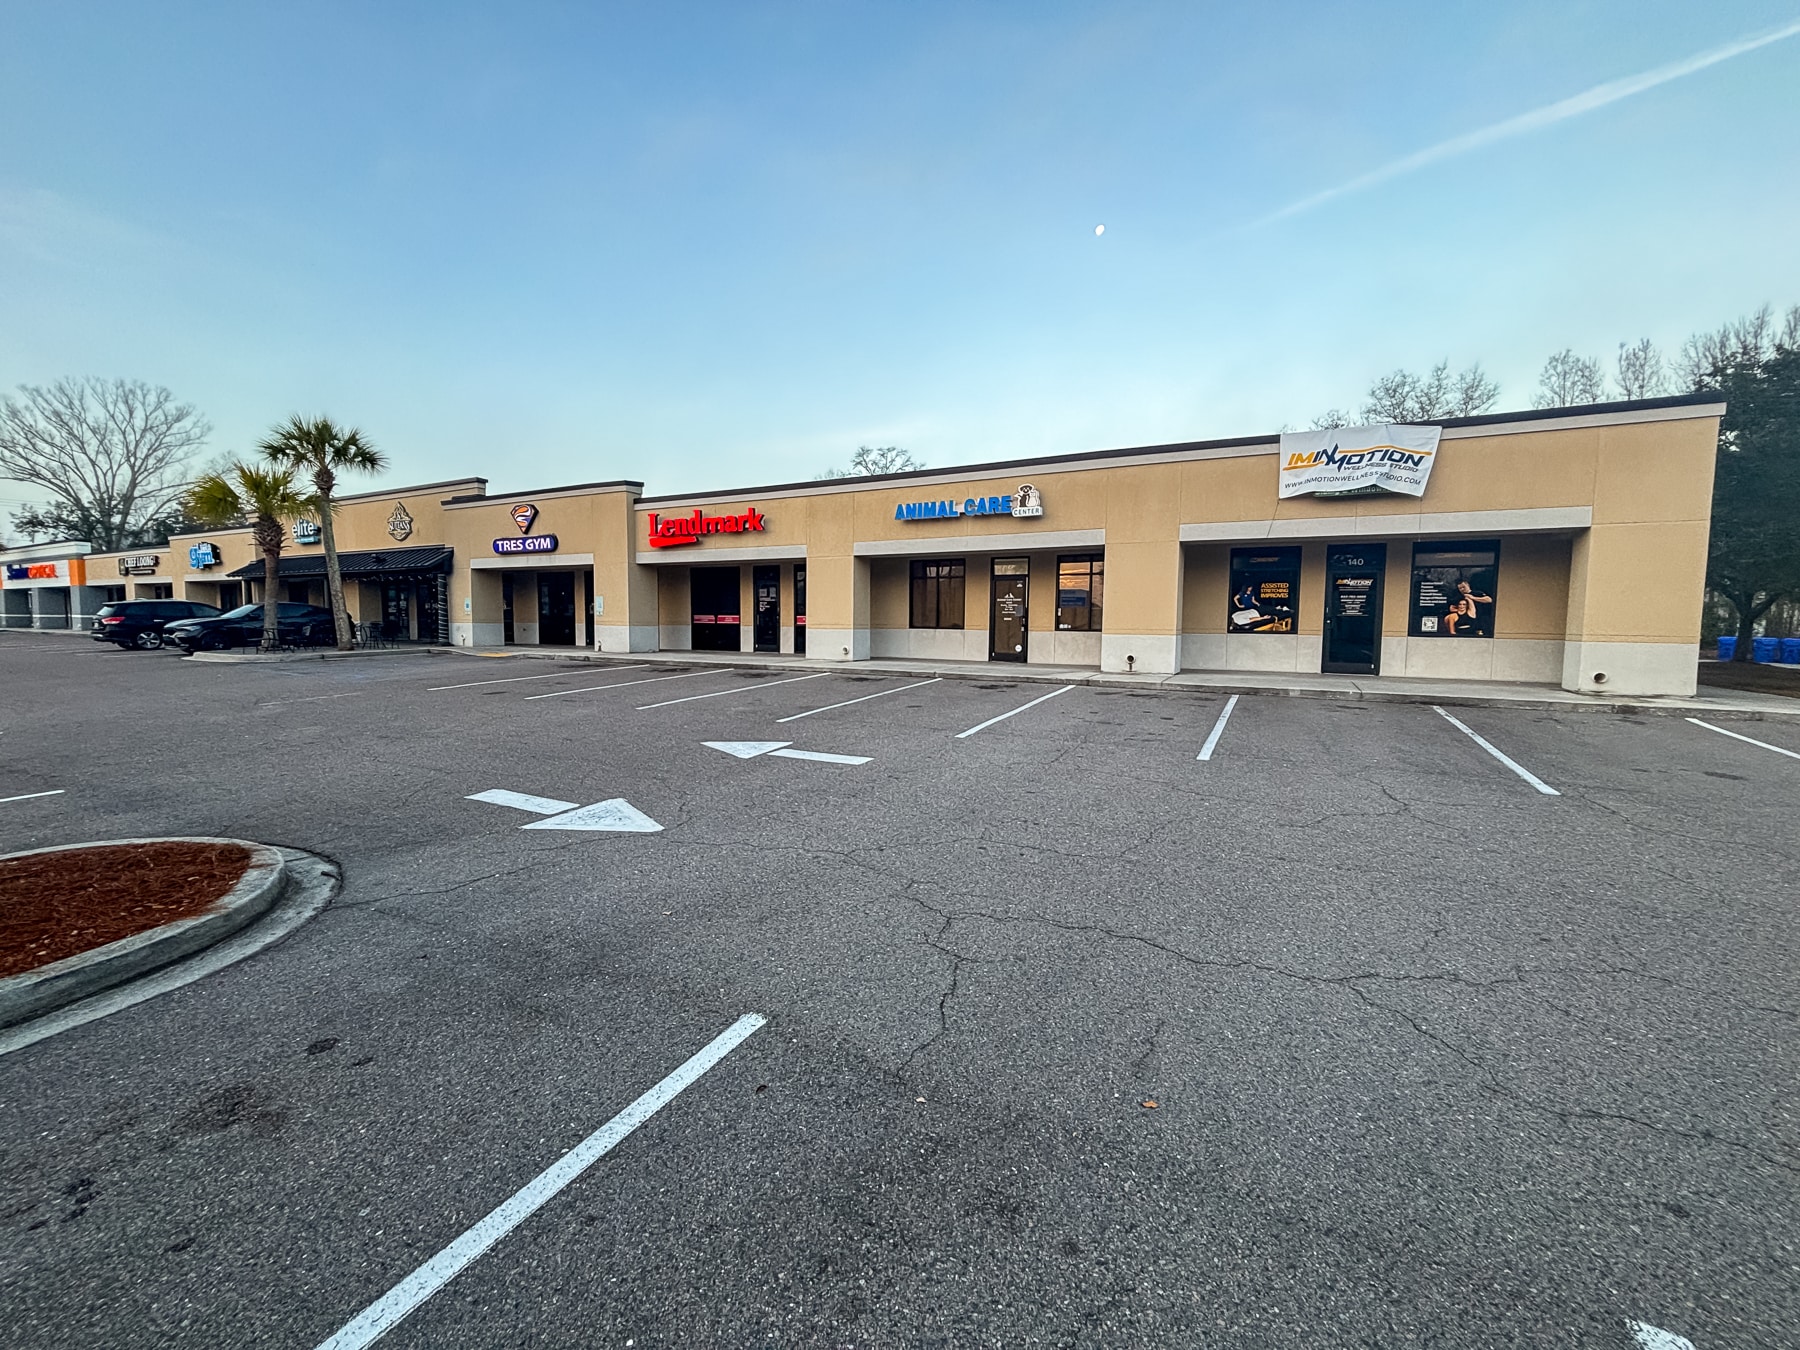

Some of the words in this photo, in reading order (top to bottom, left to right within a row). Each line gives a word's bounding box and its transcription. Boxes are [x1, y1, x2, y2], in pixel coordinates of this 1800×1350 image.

[1343, 462, 1388, 471] WELLNESS
[1389, 462, 1419, 473] STUDIO
[895, 500, 959, 520] ANIMAL
[964, 495, 1012, 516] CARE
[1013, 508, 1041, 516] CENTER
[292, 518, 314, 537] elite
[648, 507, 764, 537] Lendmark
[496, 540, 523, 552] TRES
[525, 537, 551, 550] GYM
[1348, 558, 1364, 566] 140
